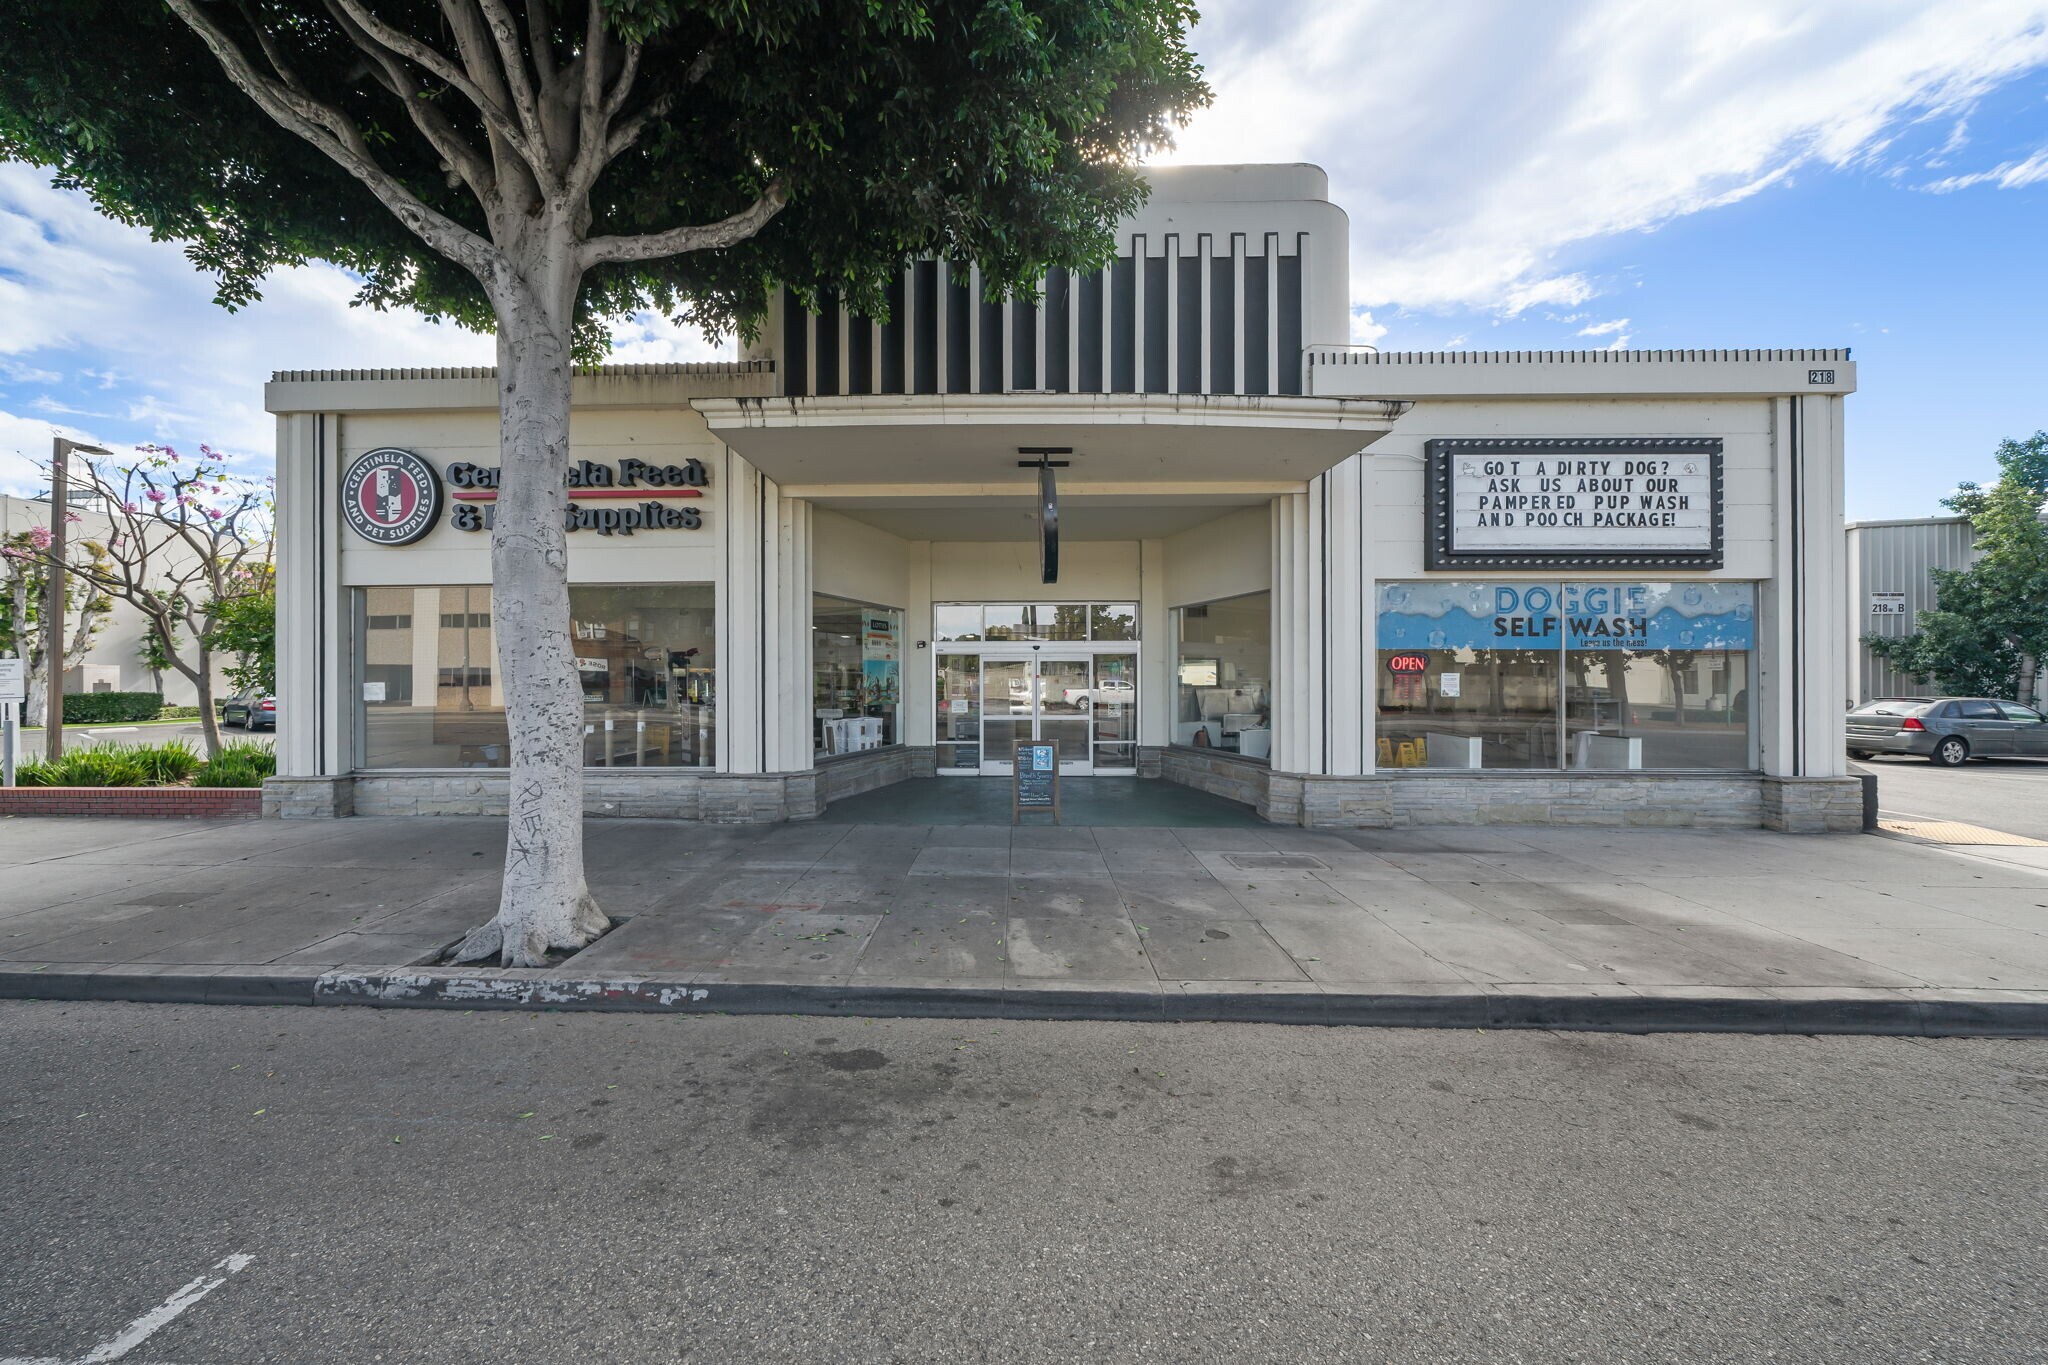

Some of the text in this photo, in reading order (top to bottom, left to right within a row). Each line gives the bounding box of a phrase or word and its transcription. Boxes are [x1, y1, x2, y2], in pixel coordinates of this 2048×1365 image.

[1811, 371, 1832, 383] 218
[349, 454, 428, 488] CENTINELA FEED
[446, 458, 706, 489] Ceela Feed
[1484, 461, 1669, 476] GOT A DIRTY DOG?
[1488, 478, 1679, 493] ASK US ABOUT OUR
[1479, 495, 1689, 510] PAMPERED PUP WASH
[348, 498, 430, 538] AND PET SUPPLIES
[451, 503, 482, 532] &
[1477, 512, 1676, 527] AND POOCH PACKAGE!
[1495, 586, 1647, 615] DOGGIE
[1872, 604, 1888, 612] 218
[1898, 604, 1904, 612] B
[1580, 638, 1600, 647] Lea
[1602, 639, 1611, 647] us
[1613, 638, 1625, 647] the
[1391, 656, 1425, 671] OPEN
